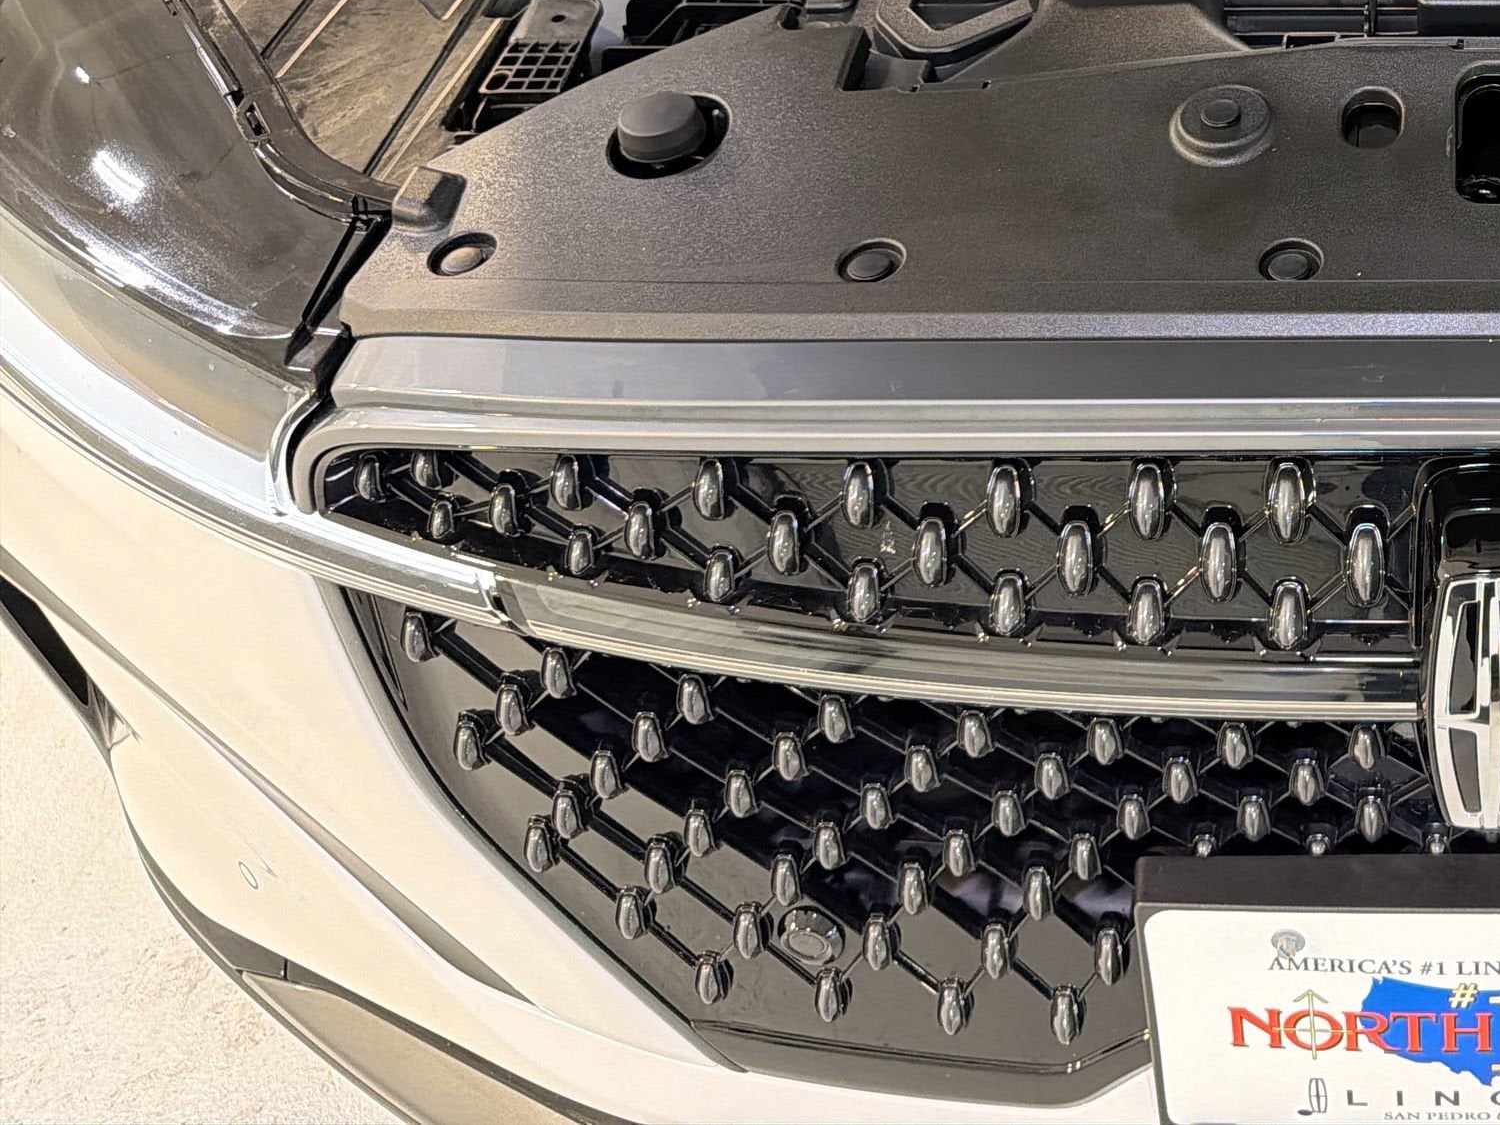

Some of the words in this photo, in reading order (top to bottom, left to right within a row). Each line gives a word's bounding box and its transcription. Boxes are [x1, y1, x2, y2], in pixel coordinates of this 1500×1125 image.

[1268, 956, 1412, 975] AMERICA'S
[1419, 961, 1447, 975] #1
[1227, 1006, 1494, 1053] NORTH
[1384, 1111, 1420, 1121] SAN
[1426, 1111, 1491, 1121] PEDRO
